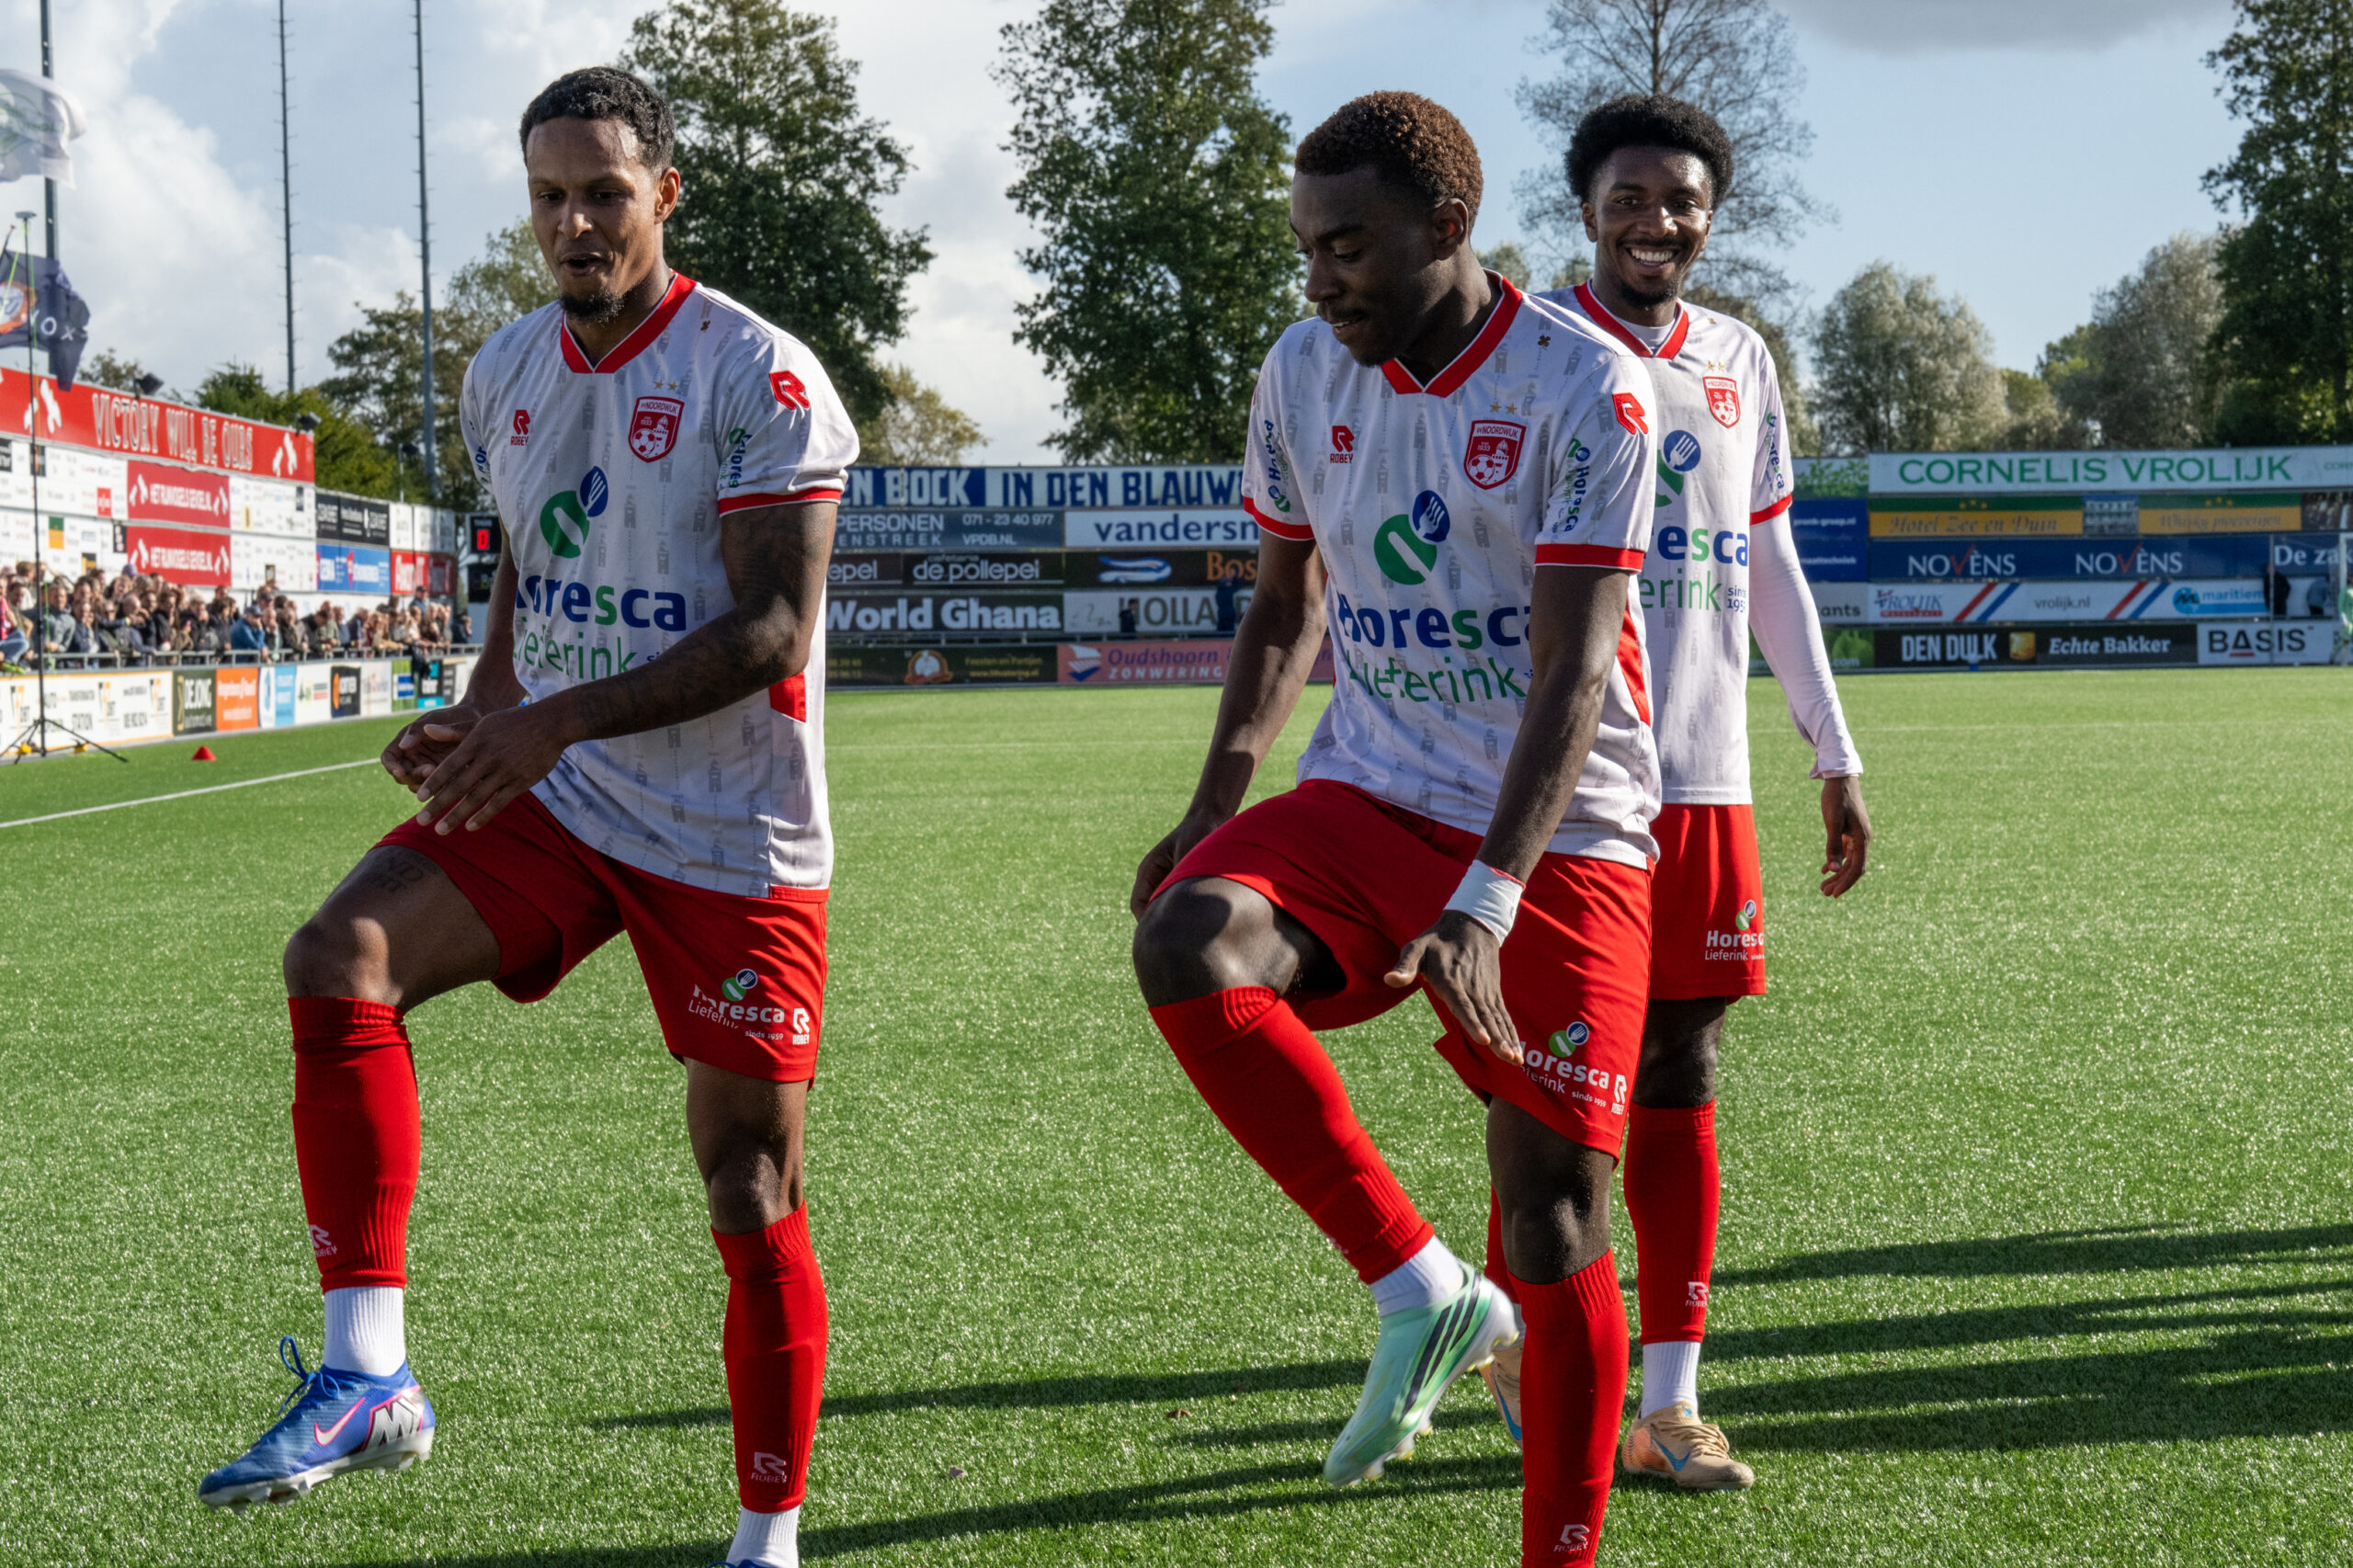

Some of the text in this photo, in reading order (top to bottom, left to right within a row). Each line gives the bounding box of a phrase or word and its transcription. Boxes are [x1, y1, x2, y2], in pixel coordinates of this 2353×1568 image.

[92, 392, 253, 472] VICTORY WILL BE OURS
[510, 436, 529, 446] ROBEY
[1330, 453, 1353, 463] ROBEY
[1899, 455, 2292, 484] CORNELIS VROLIJK
[884, 469, 971, 506] BOCK
[1002, 472, 1033, 507] IN
[1046, 472, 1108, 507] DEN
[1121, 470, 1242, 507] BLAUW
[962, 514, 983, 526] 071
[995, 514, 1010, 526] 23
[1013, 514, 1030, 526] 40
[1032, 514, 1053, 526] 977
[1889, 514, 1939, 534] Hotel
[1984, 518, 2005, 533] en
[2012, 514, 2058, 532] Duin
[477, 529, 488, 550] 0
[838, 534, 941, 545] ENSTREEK
[962, 534, 1017, 545] VPDB.NL
[2274, 545, 2307, 566] De
[827, 560, 878, 584] epel
[913, 560, 944, 581] de
[1640, 568, 1722, 612] erink
[825, 597, 1061, 631] World Ghana
[2034, 597, 2091, 611] vrolijk.nl
[1902, 633, 1997, 661] DEN DULK
[2049, 636, 2172, 654] Echte Bakker
[2208, 629, 2306, 653] BASIS
[1108, 647, 1218, 665] Oudshoorn
[1108, 666, 1223, 680] ZONWERING
[1705, 949, 1748, 960] Lieferink
[745, 1029, 765, 1039] sinds
[1520, 1040, 1609, 1089] oresca
[1572, 1090, 1607, 1108] sinds 1959
